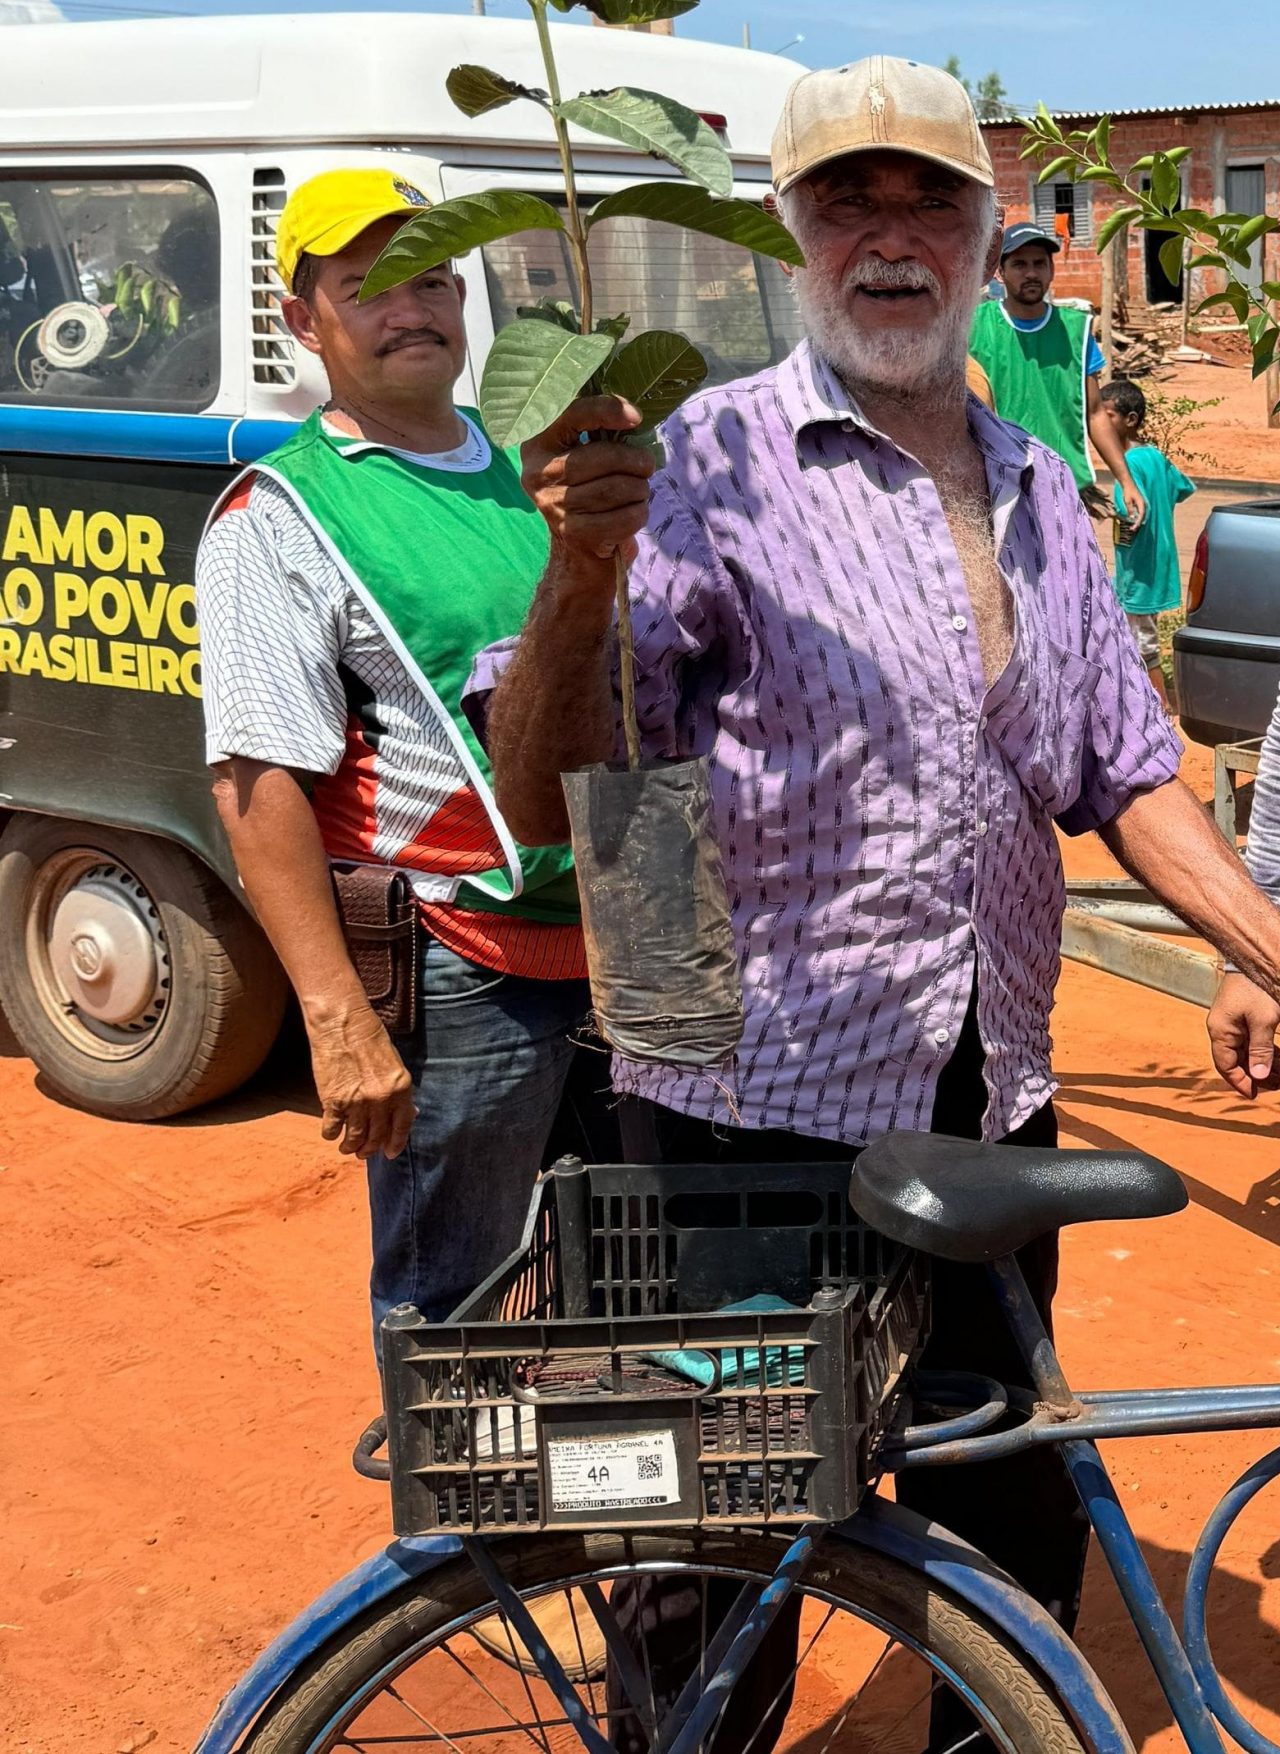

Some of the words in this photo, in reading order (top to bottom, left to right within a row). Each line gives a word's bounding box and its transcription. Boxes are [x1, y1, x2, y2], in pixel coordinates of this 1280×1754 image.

[2, 505, 166, 575] AMOR
[0, 567, 44, 626] O
[54, 572, 201, 645] POVO
[587, 1465, 610, 1483] 4A
